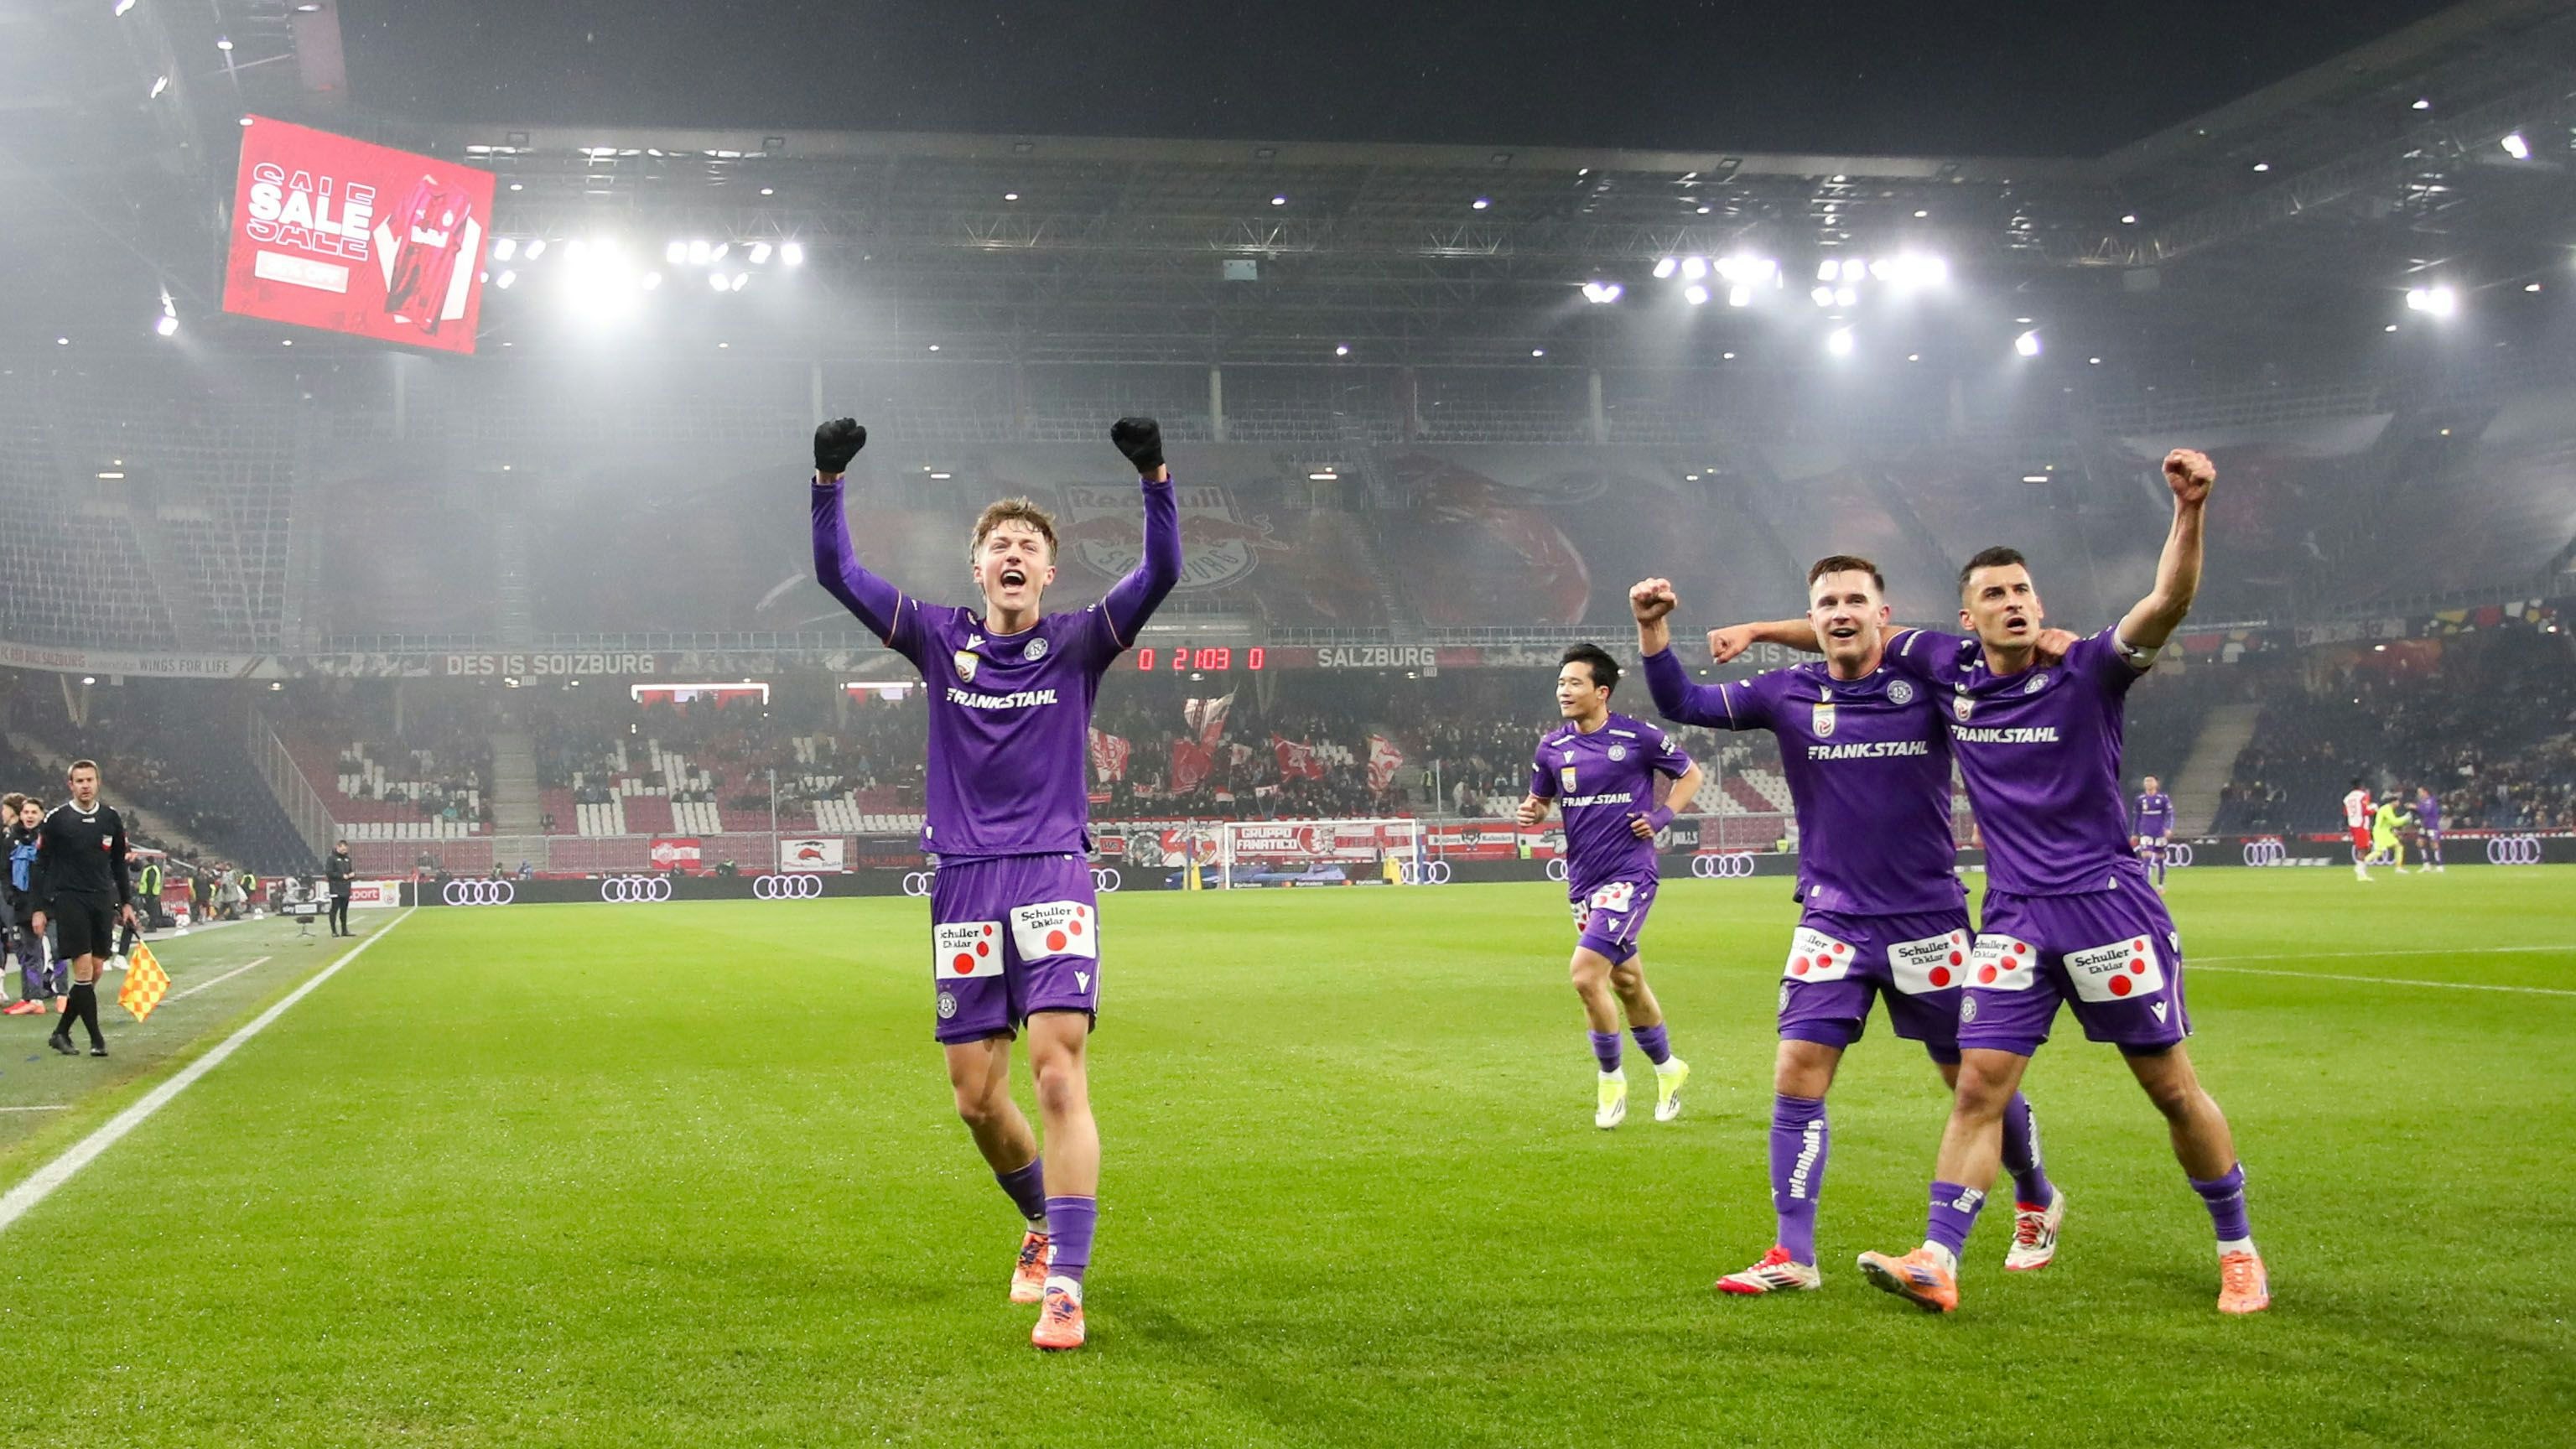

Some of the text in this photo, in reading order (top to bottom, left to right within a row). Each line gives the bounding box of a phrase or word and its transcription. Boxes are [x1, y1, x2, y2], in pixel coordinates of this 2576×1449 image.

[248, 182, 373, 242] SALE
[139, 658, 175, 672] WINGS
[179, 660, 202, 673] FOR
[206, 660, 230, 673] LIFE
[447, 654, 655, 675] DES IS SOIZBURG
[1139, 647, 1264, 671] 0 21:03 0
[1318, 647, 1436, 667] SALZBURG
[946, 687, 1058, 709] FRANKSTAHL
[1951, 724, 2059, 743] FRANKSTAHL
[1808, 740, 1929, 761] FRANKSTAHL
[1562, 792, 1633, 808] FRANKSTAHL
[1241, 827, 1292, 839] GRUPPO
[1236, 839, 1298, 850] FANATICO
[350, 888, 379, 901] port
[1021, 906, 1072, 922] Schuller
[1898, 941, 1950, 958] Schuller
[1974, 939, 2008, 951] chuller
[2075, 948, 2130, 968] Schuller
